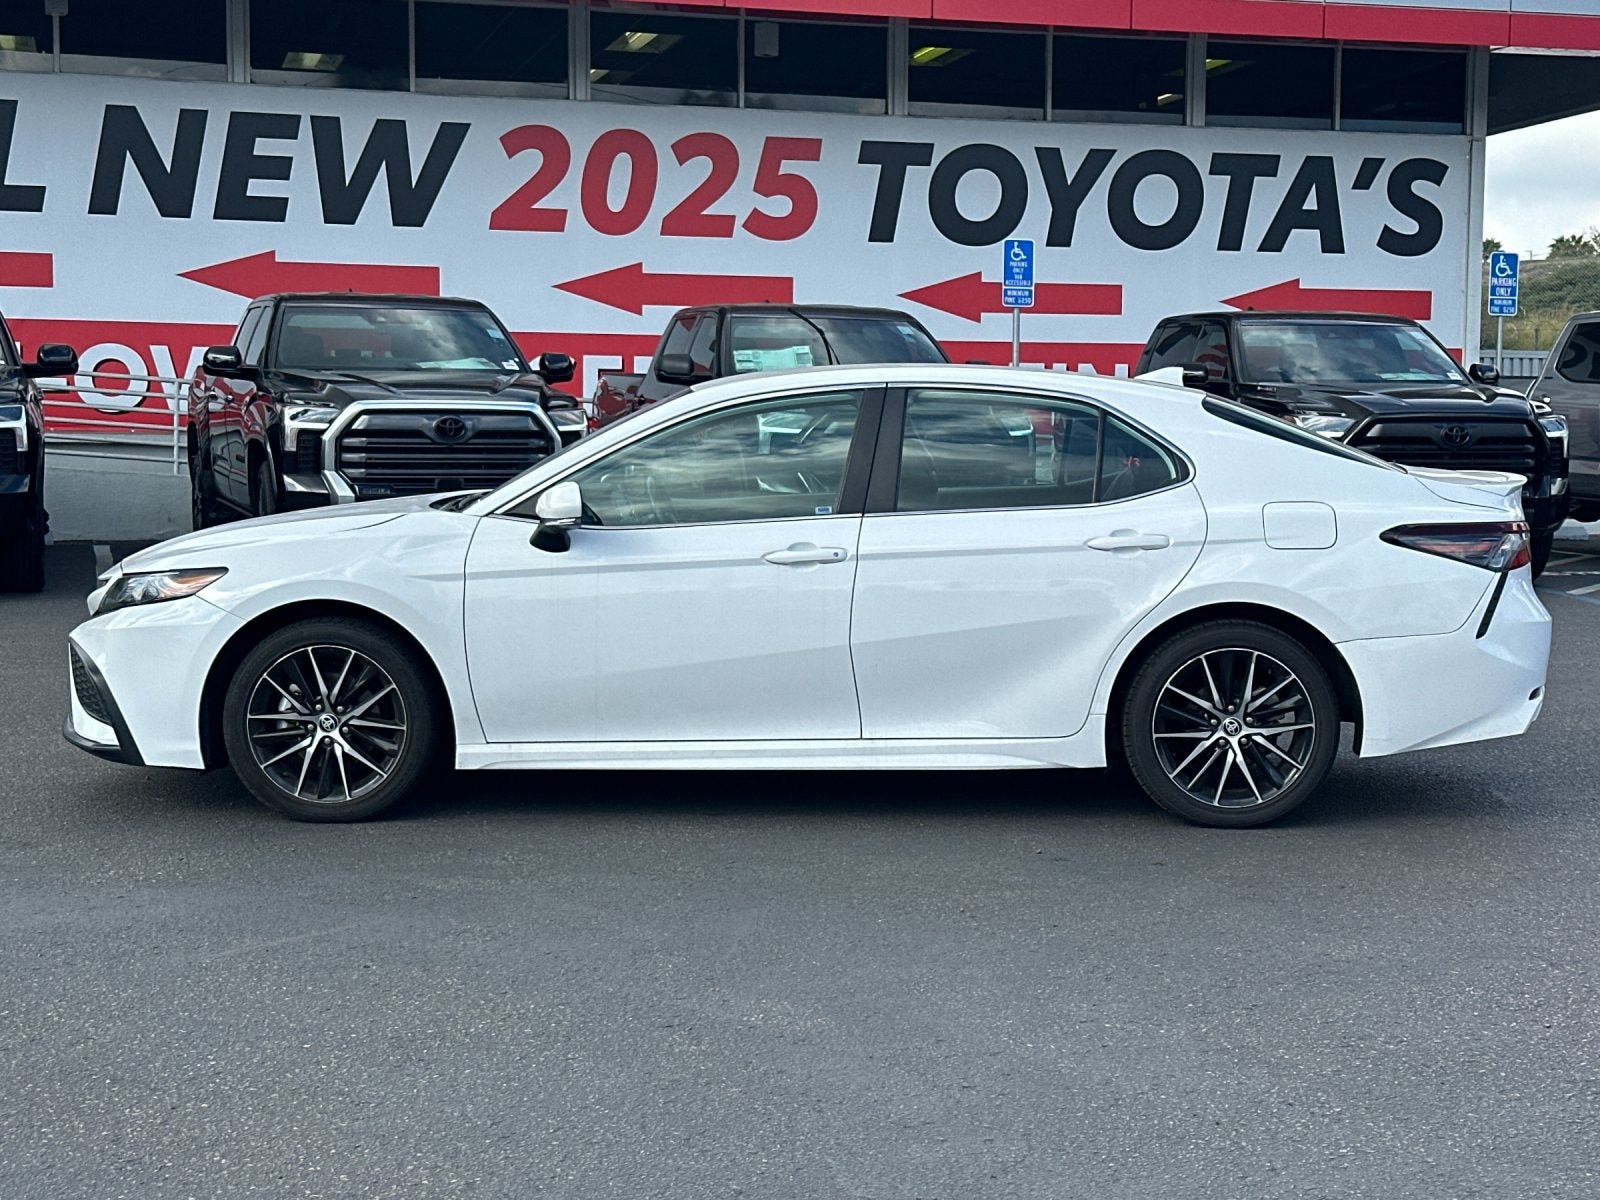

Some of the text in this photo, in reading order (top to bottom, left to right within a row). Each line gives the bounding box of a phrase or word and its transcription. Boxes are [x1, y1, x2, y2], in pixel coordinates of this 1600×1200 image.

[88, 104, 471, 228] NEW
[490, 124, 820, 242] 2025
[858, 140, 1449, 256] TOYOTA'S
[1491, 278, 1517, 287] PARKING
[1496, 287, 1511, 296] ONLY
